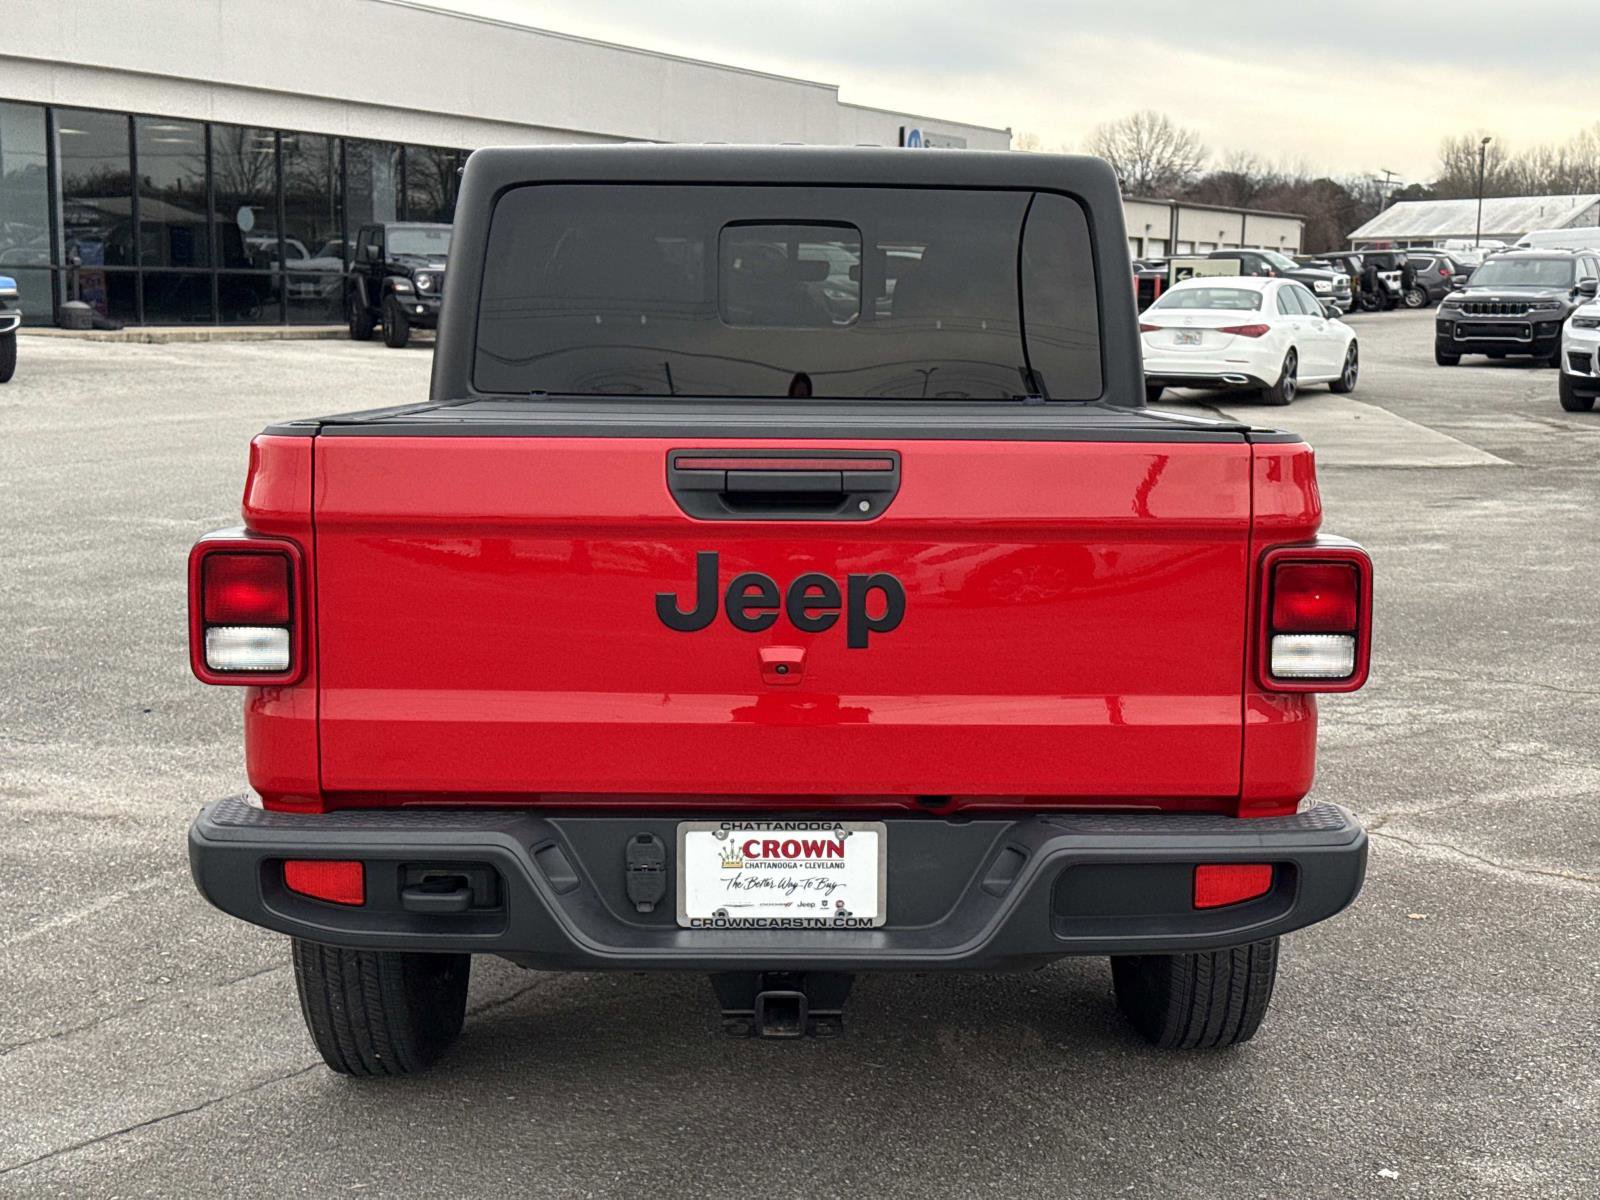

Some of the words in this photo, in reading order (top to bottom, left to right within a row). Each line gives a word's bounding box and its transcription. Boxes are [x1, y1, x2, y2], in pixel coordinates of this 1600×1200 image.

[655, 550, 906, 649] Jeep
[720, 822, 844, 831] CHATTANOOGA
[742, 839, 845, 859] CROWN
[744, 861, 798, 870] CHATTANOOGA
[804, 862, 846, 870] CLEVELAND
[720, 872, 743, 891] The
[743, 876, 776, 891] Better
[777, 877, 798, 896] Way
[799, 877, 814, 890] To
[814, 877, 847, 897] Buy
[690, 917, 874, 929] CROWNCARSTN.COM
